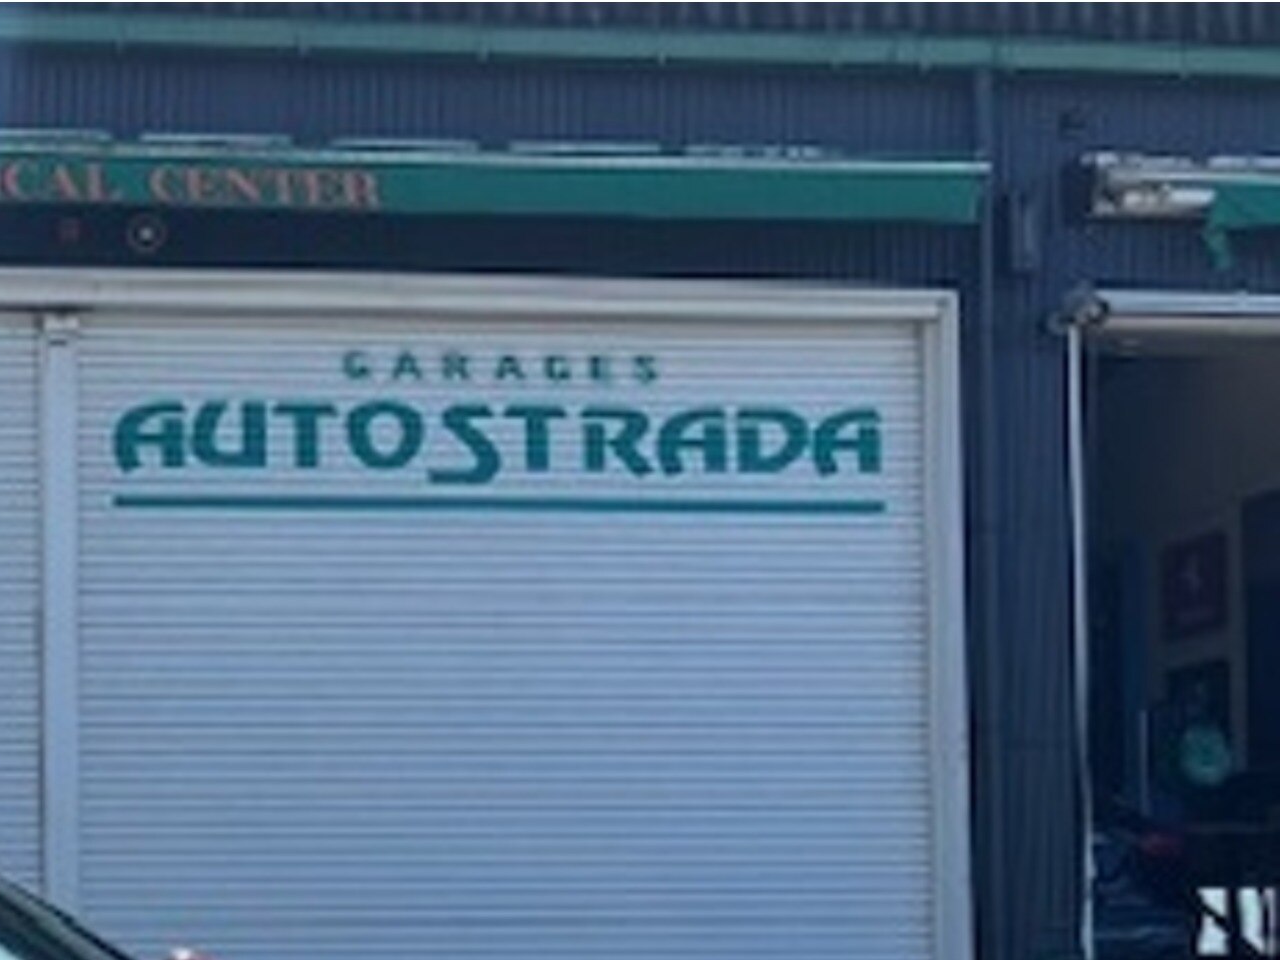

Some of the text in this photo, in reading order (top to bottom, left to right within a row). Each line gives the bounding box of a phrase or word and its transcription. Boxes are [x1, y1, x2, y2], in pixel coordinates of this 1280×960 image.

[148, 165, 382, 212] CENTER
[341, 350, 662, 384] GARAGES
[113, 400, 883, 486] AUTOSTRADA
